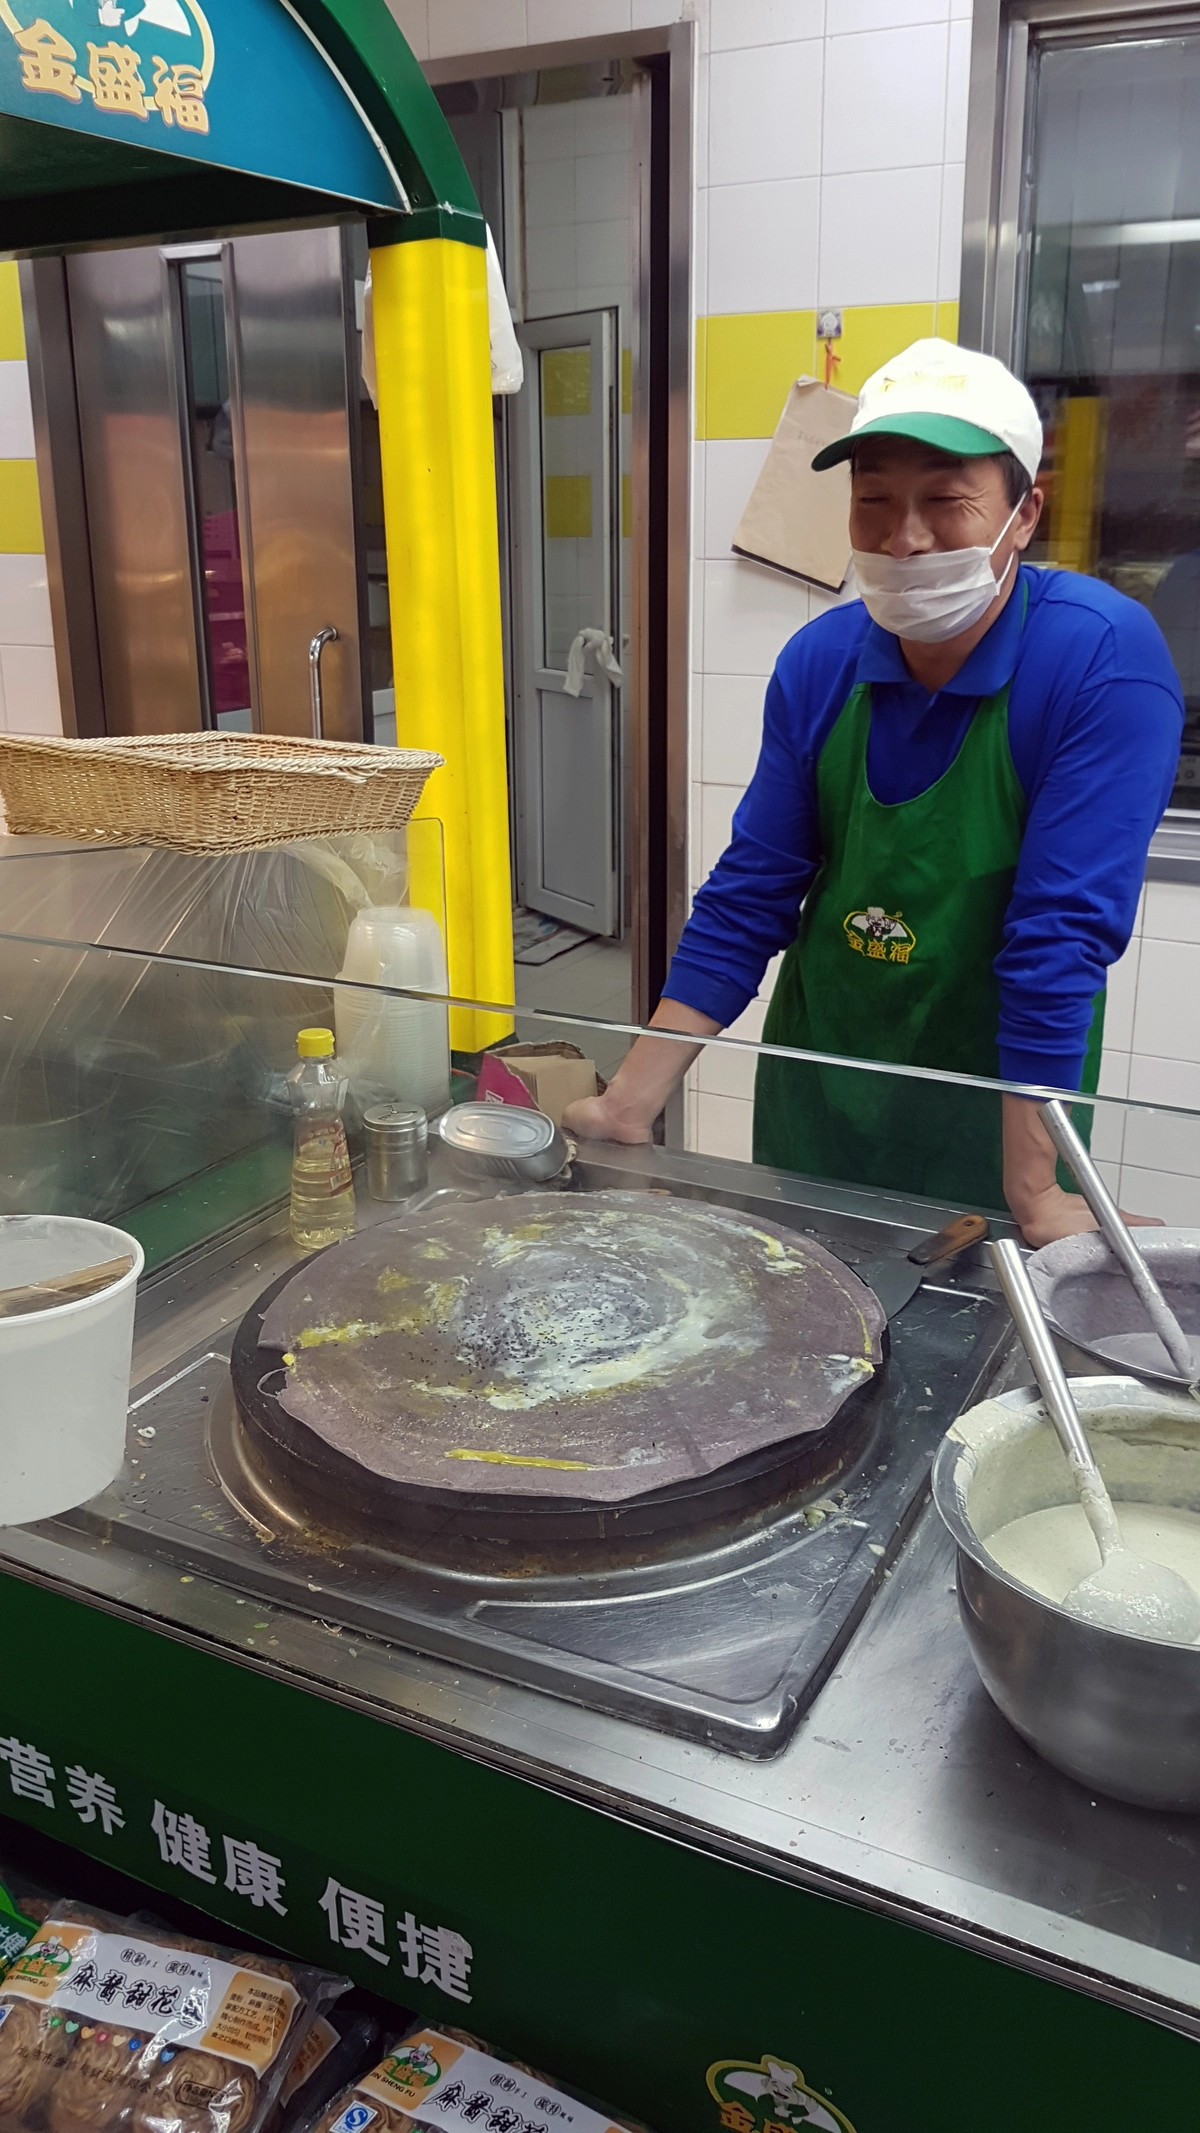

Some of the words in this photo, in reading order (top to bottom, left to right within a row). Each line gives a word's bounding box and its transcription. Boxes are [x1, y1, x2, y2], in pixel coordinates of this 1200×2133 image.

[14, 18, 210, 135] 金盛福
[846, 930, 911, 964] 金盛福
[0, 1736, 126, 1836] 营养
[151, 1798, 289, 1917] 健康
[317, 1876, 474, 2004] 便捷
[369, 2071, 381, 2081] JIN
[380, 2076, 405, 2094] SHENG
[404, 2088, 416, 2099] FU
